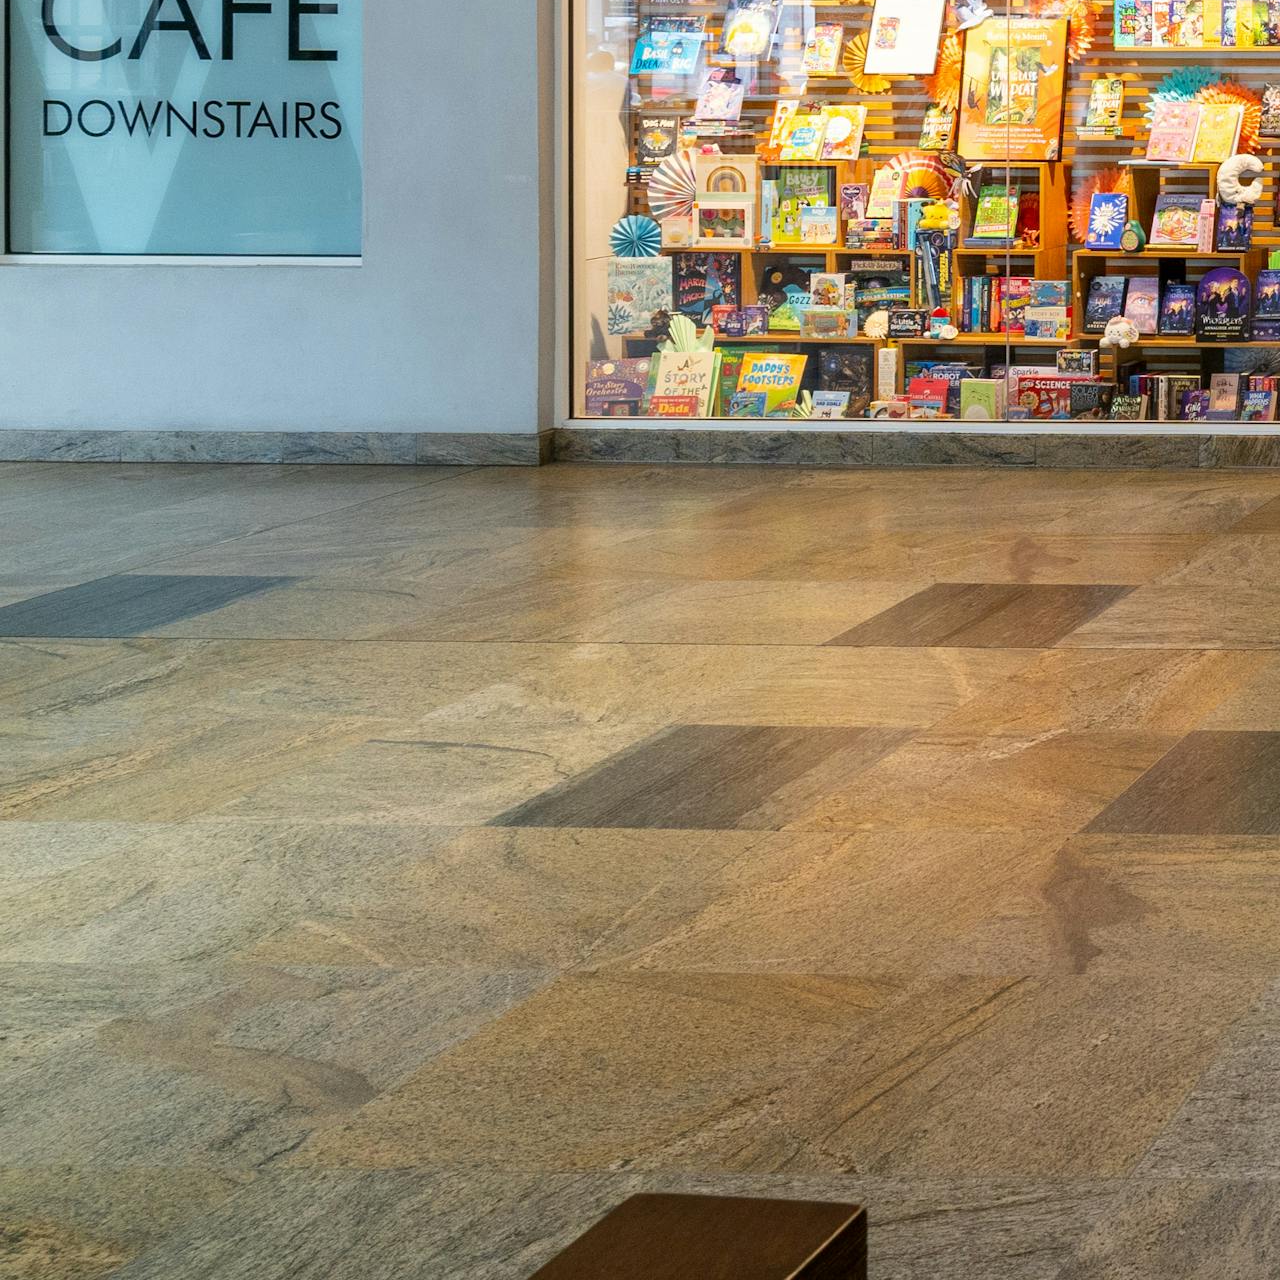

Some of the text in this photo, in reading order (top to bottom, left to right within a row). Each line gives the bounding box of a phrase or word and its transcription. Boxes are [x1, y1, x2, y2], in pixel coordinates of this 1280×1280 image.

[43, 100, 343, 139] DOWNSTAIRS
[642, 120, 676, 128] DOG MAN
[751, 362, 790, 374] DADDY'S
[664, 371, 705, 383] STORY
[742, 374, 794, 386] FOOTSTEPS
[1035, 381, 1071, 389] SCIENCE
[664, 386, 700, 395] OF THE
[1072, 386, 1098, 394] SOLAR
[1072, 394, 1098, 402] SYSTEM
[658, 403, 689, 413] Dads
